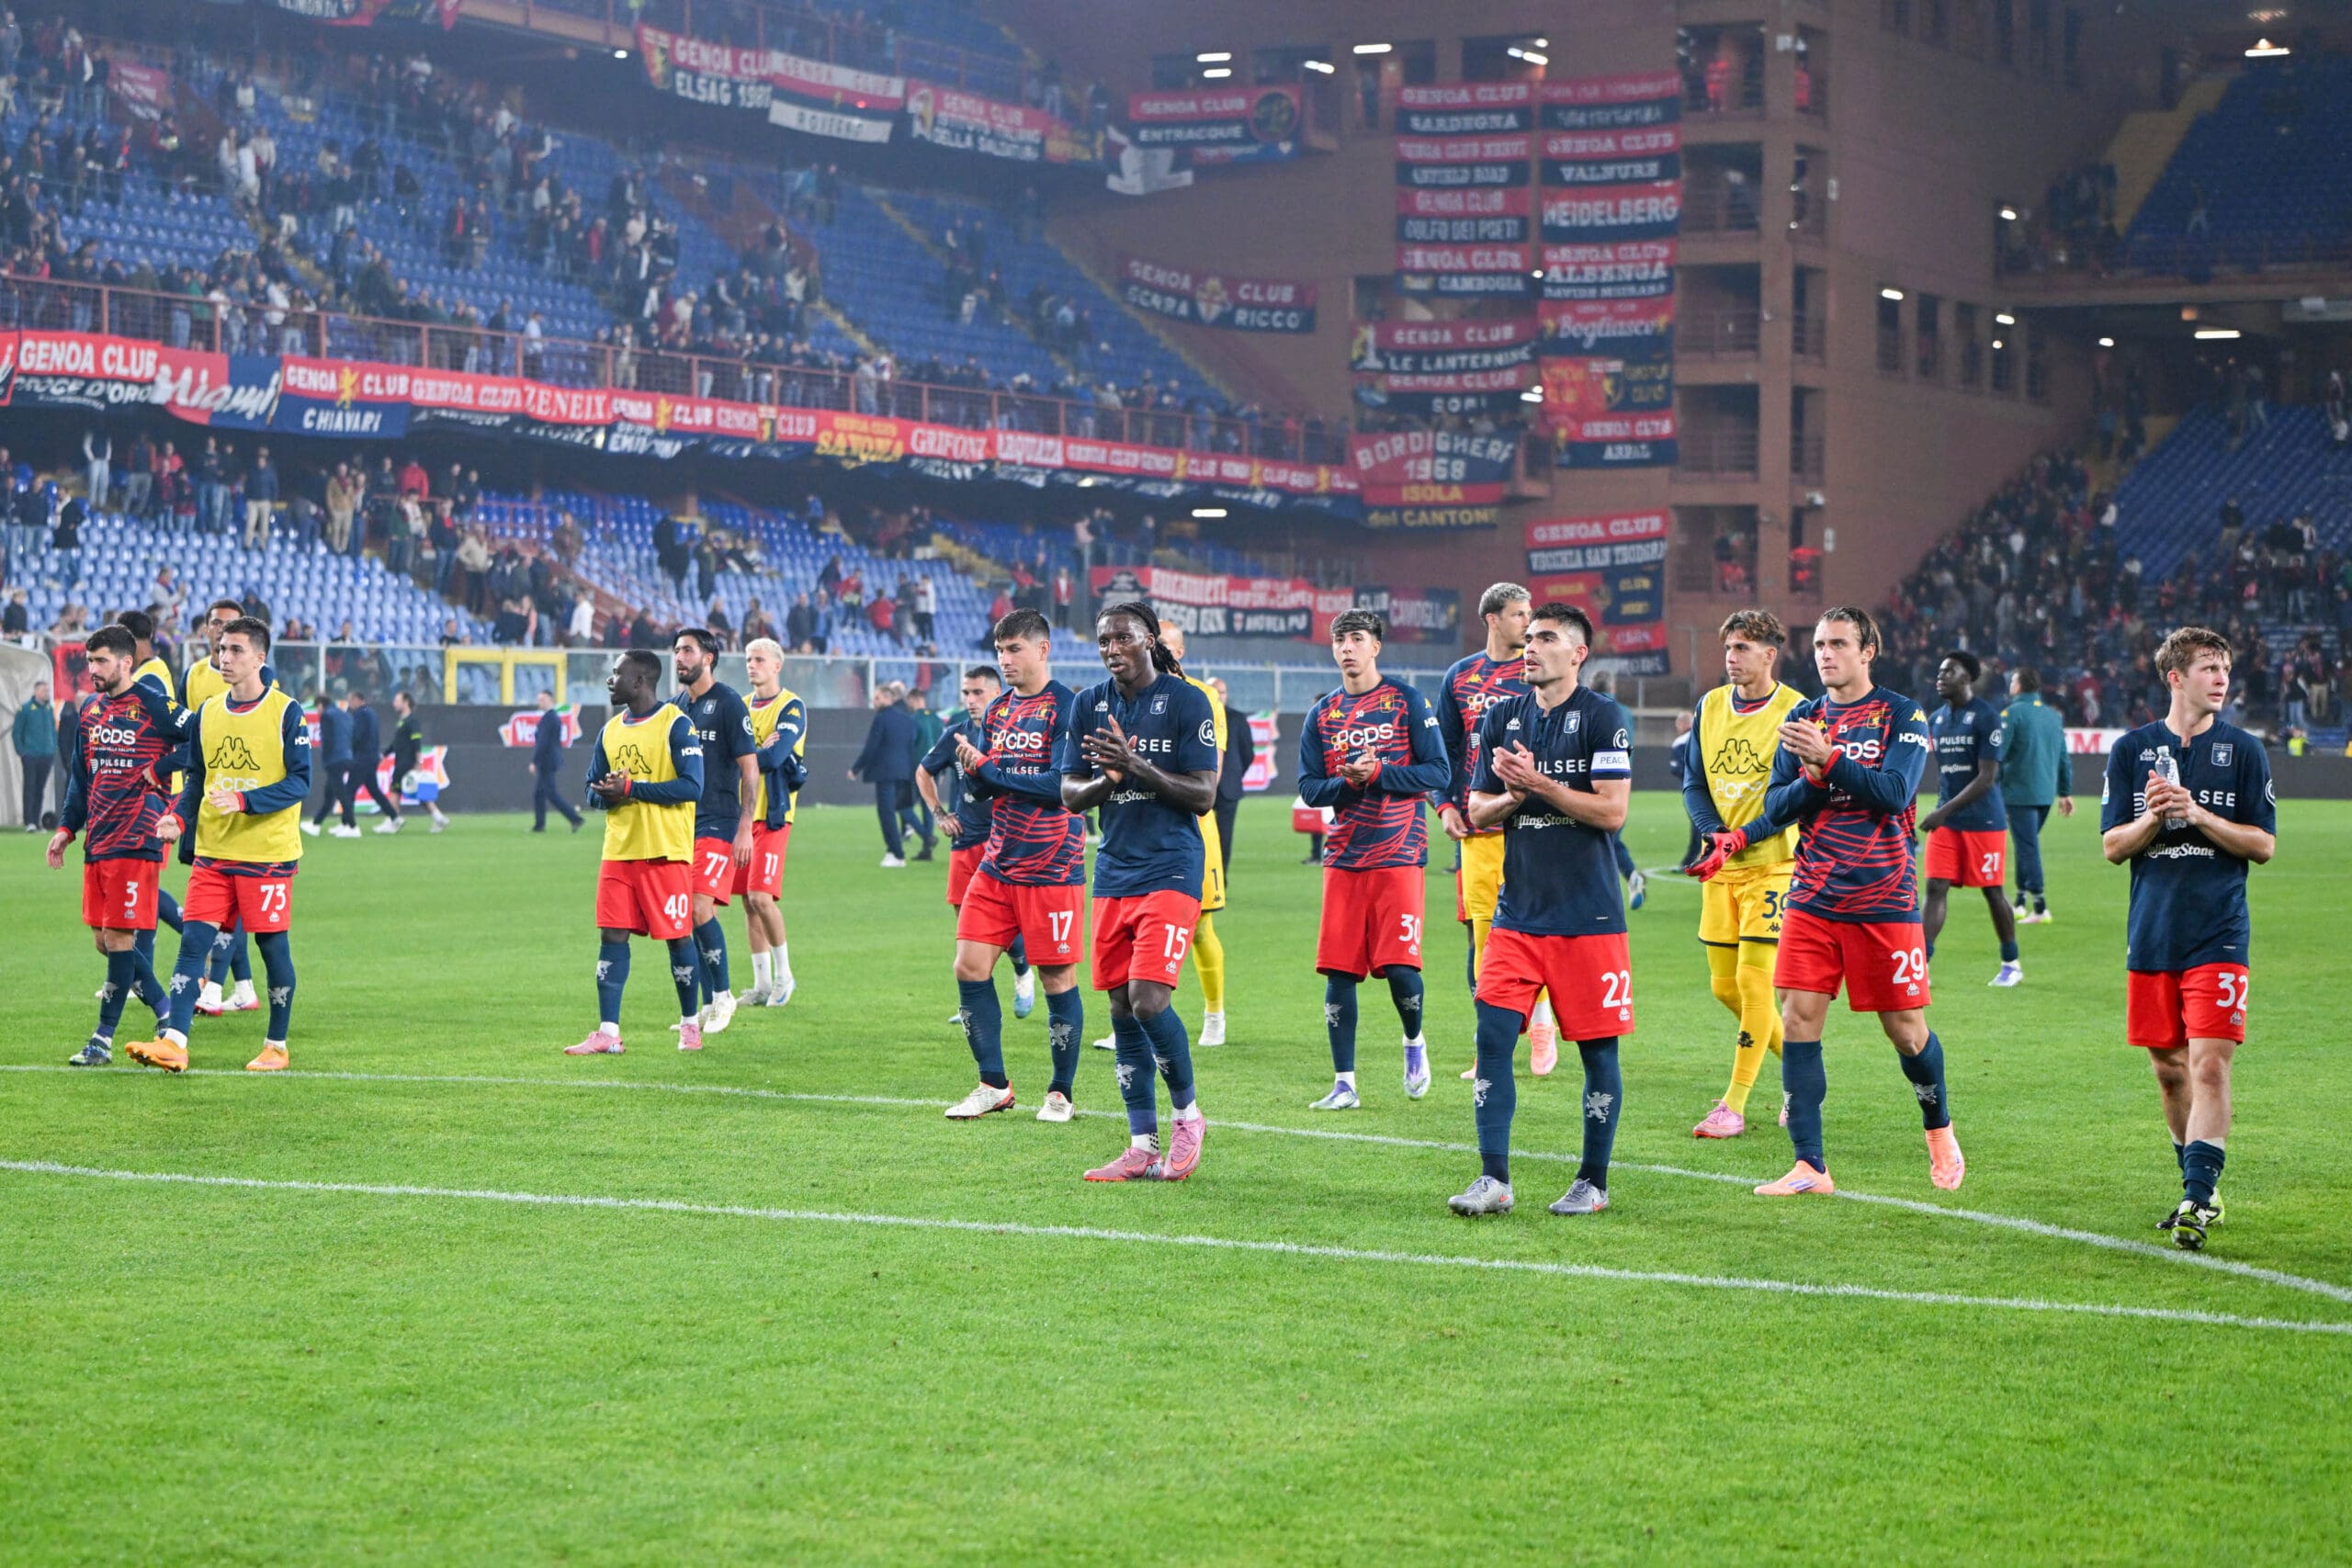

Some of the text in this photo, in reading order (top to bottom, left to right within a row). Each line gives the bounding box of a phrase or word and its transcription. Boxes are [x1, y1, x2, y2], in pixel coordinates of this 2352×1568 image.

[675, 38, 732, 73] GENOA
[675, 71, 732, 107] ELSAG
[1402, 85, 1471, 104] GENOA
[1476, 84, 1529, 101] CLUB
[1140, 97, 1247, 115] GENOA CLUB
[1139, 125, 1243, 142] ENTRACQUE
[1409, 113, 1519, 132] SARDEGNA
[1547, 132, 1675, 155] GENOA CLUB
[1543, 195, 1679, 227] HEIDELBERG
[1471, 249, 1522, 270] CLUB
[1129, 260, 1295, 303] GENOA CLUB
[1547, 261, 1668, 284] ALBENGA
[1394, 324, 1515, 346] GENOA CLUB
[20, 339, 96, 374] GENOA
[102, 344, 158, 379] CLUB
[285, 364, 410, 396] GENOA CLUB
[411, 378, 474, 405] GENOA
[1463, 371, 1517, 389] CLUB
[673, 403, 713, 426] CLUB
[1431, 396, 1488, 413] SORI
[301, 407, 384, 433] CHIAVARI
[778, 413, 817, 436] CLUB
[1403, 459, 1466, 481] 1968
[1401, 485, 1464, 502] ISOLA
[1532, 516, 1663, 543] GENOA CLUB
[100, 728, 137, 745] CDS
[1005, 731, 1043, 750] CDS
[1349, 723, 1394, 746] CDS
[1939, 736, 1974, 745] PULSEE
[99, 759, 133, 768] PULSEE
[1536, 759, 1588, 774] ULSEE
[703, 852, 729, 879] 77
[764, 852, 779, 877] 11
[1981, 852, 2001, 873] 21
[1211, 868, 1218, 891] 1
[124, 881, 139, 908] 3
[259, 884, 287, 912] 73
[663, 893, 688, 919] 40
[1047, 910, 1074, 942] 17
[1398, 913, 1421, 945] 30
[1163, 923, 1189, 961] 15
[1891, 947, 1925, 985] 29
[1600, 969, 1632, 1009] 22
[2216, 972, 2248, 1012] 32
